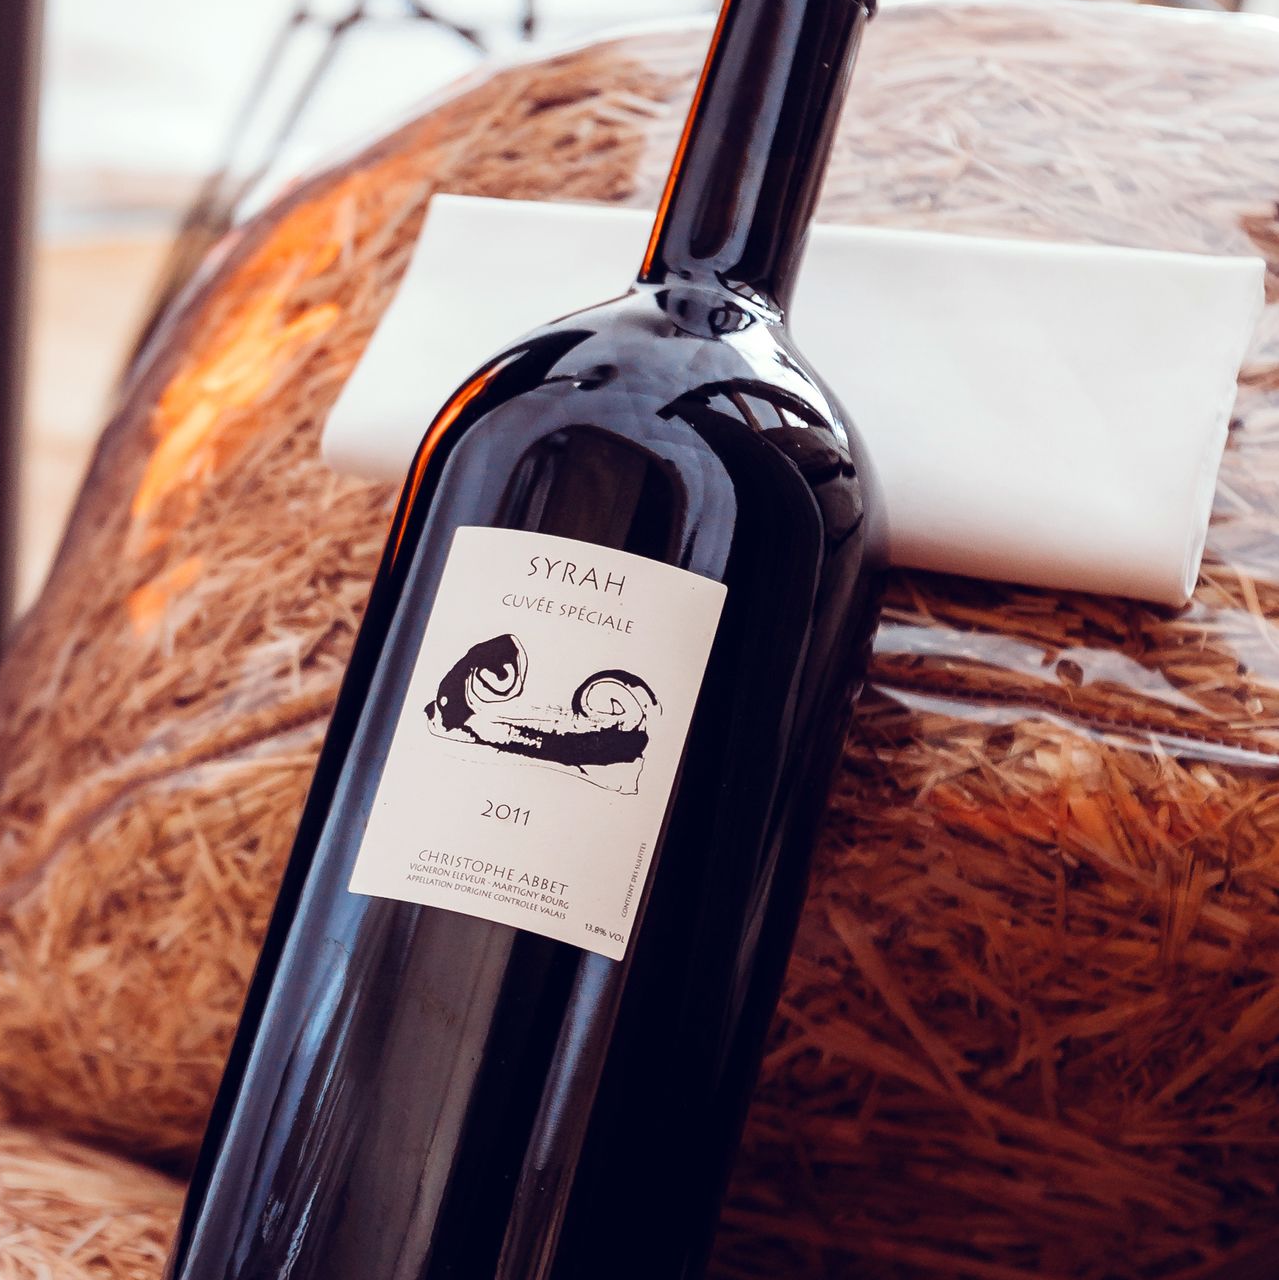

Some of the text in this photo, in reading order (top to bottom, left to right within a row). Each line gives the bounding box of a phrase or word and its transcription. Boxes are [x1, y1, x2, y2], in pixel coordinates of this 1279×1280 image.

[528, 556, 626, 596] SYRAH
[502, 593, 635, 634] CUVÉE SPÉCIALE
[480, 799, 531, 826] 2011
[409, 862, 451, 877] VIGNERON
[452, 871, 486, 885] ELEVEUR
[492, 881, 540, 899] MARTIGNY
[540, 894, 570, 909] BOURG
[418, 849, 569, 896] CHRISTOPHE ABBET
[621, 843, 647, 918] CONTIENT DES SULFITES
[406, 874, 453, 889] APPELLATION
[493, 893, 538, 911] CONTROLEE
[538, 906, 567, 920] VALAIS
[585, 923, 625, 944] 13.8% VOL
